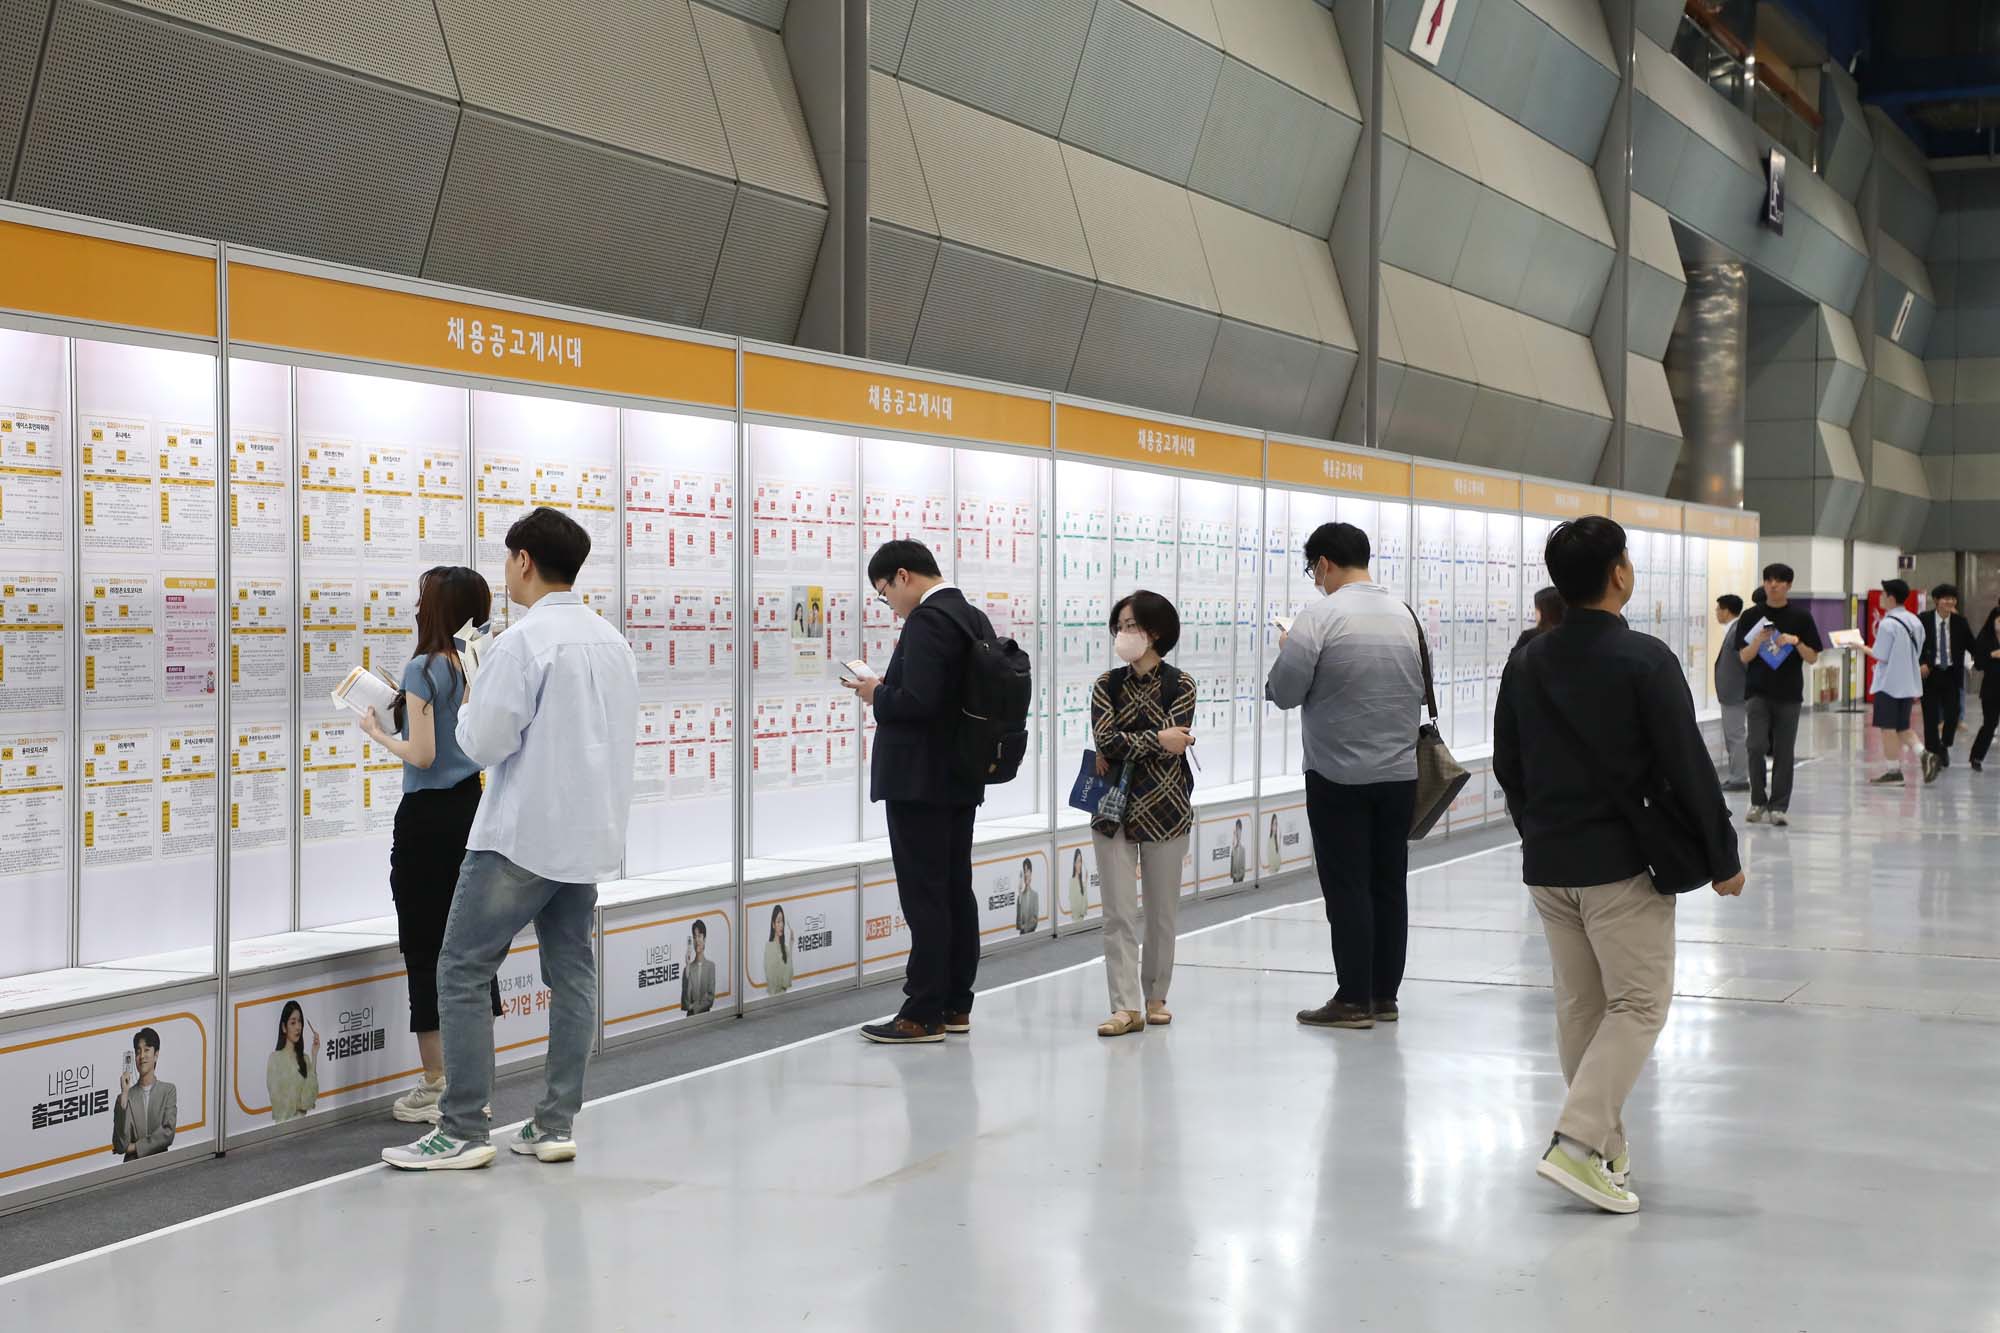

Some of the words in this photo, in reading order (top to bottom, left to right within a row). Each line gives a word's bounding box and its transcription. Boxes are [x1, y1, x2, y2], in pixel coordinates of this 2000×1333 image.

[447, 317, 582, 368] 채용공고게시대
[868, 385, 952, 422] 채용공고게시대
[1138, 428, 1195, 457] 채용공고게시대
[797, 930, 833, 953] 취업준비를
[865, 916, 892, 940] KB굿잡
[646, 944, 672, 966] 내일의
[498, 978, 513, 993] 023
[514, 973, 533, 990] 제1차
[638, 962, 680, 989] 출근준비로
[338, 1006, 374, 1034] 오늘의
[501, 993, 531, 1020] 수기업
[326, 1027, 385, 1062] 취업준비를
[48, 1063, 94, 1097] 내일의
[31, 1088, 109, 1130] 출근준비로
